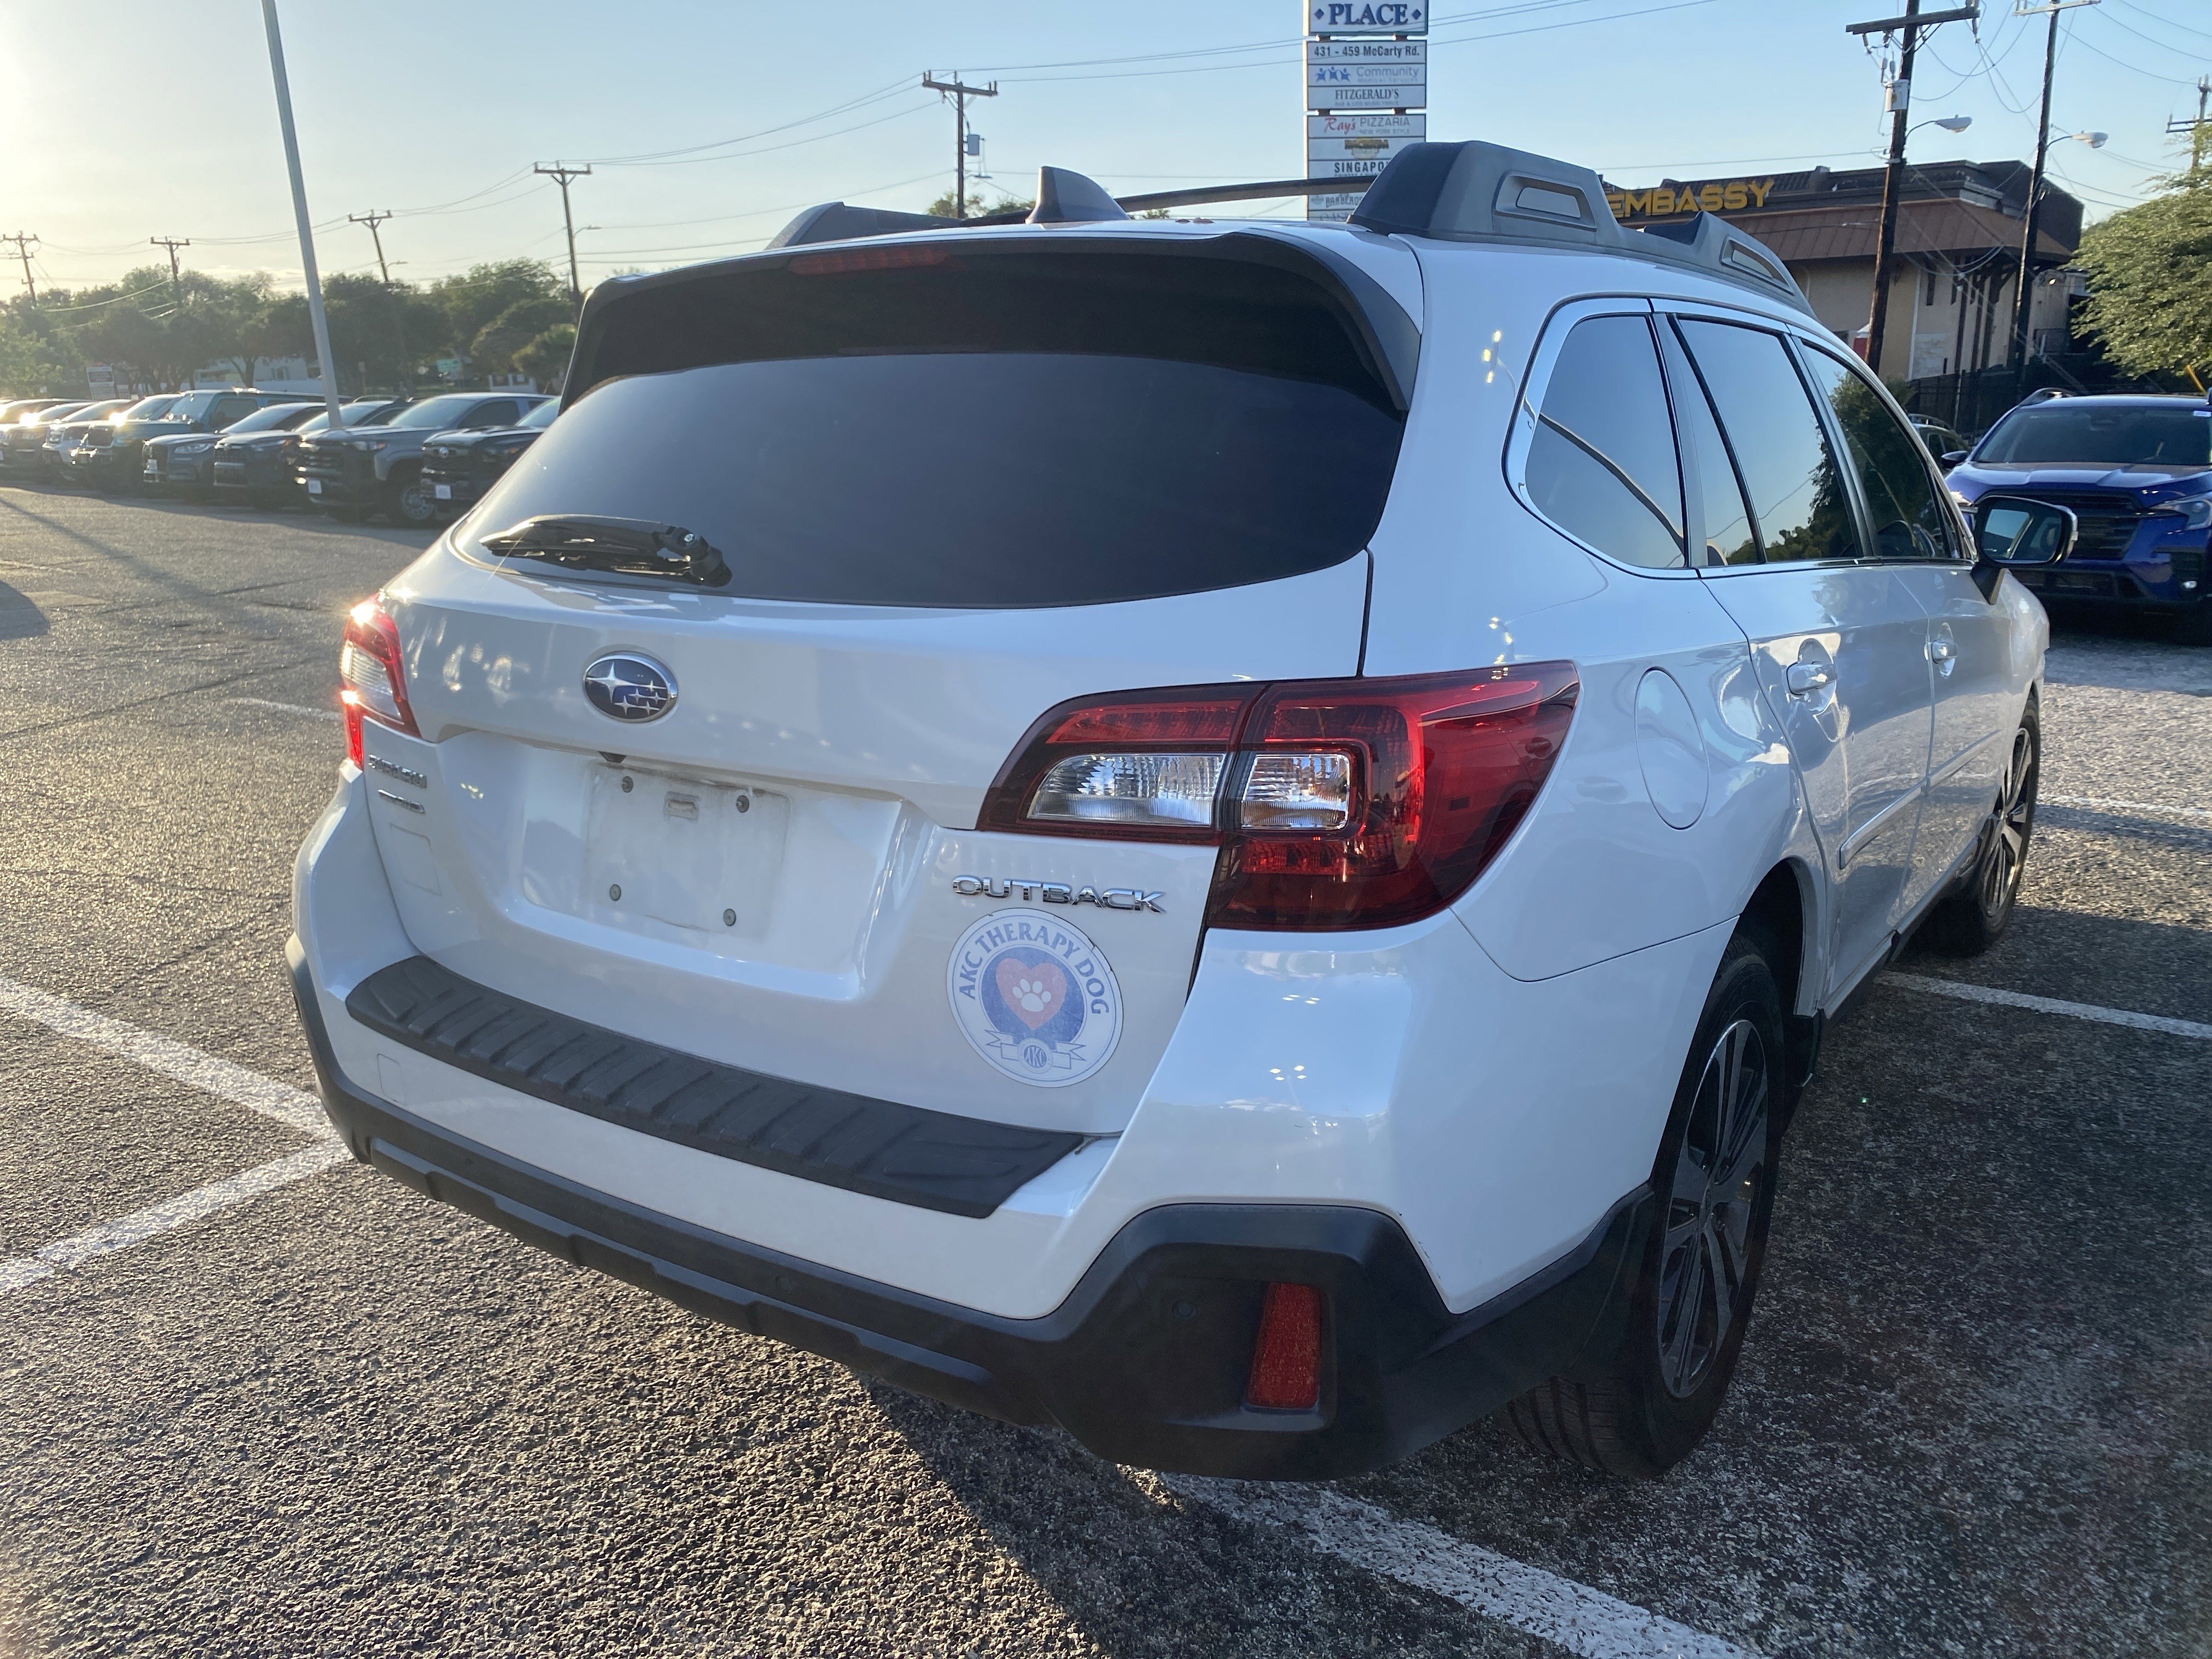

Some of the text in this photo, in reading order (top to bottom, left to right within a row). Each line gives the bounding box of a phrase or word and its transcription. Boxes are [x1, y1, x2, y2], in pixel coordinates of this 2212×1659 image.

[1328, 3, 1408, 25] PLACE
[1314, 46, 1331, 57] 431
[1342, 46, 1360, 57] 459
[1363, 46, 1402, 58] McCarty
[1406, 46, 1420, 56] Rd.
[1356, 66, 1419, 78] Community
[1335, 88, 1400, 99] FITZGERALD'S
[1323, 116, 1410, 135] Ray's PIZZARIA
[1334, 161, 1389, 173] SINGAPO
[1606, 177, 1775, 218] EMBASSY
[952, 875, 1167, 913] OUTBACK
[958, 922, 1109, 1014] AKC THERAPY DOG
[1024, 1045, 1047, 1068] AKC
